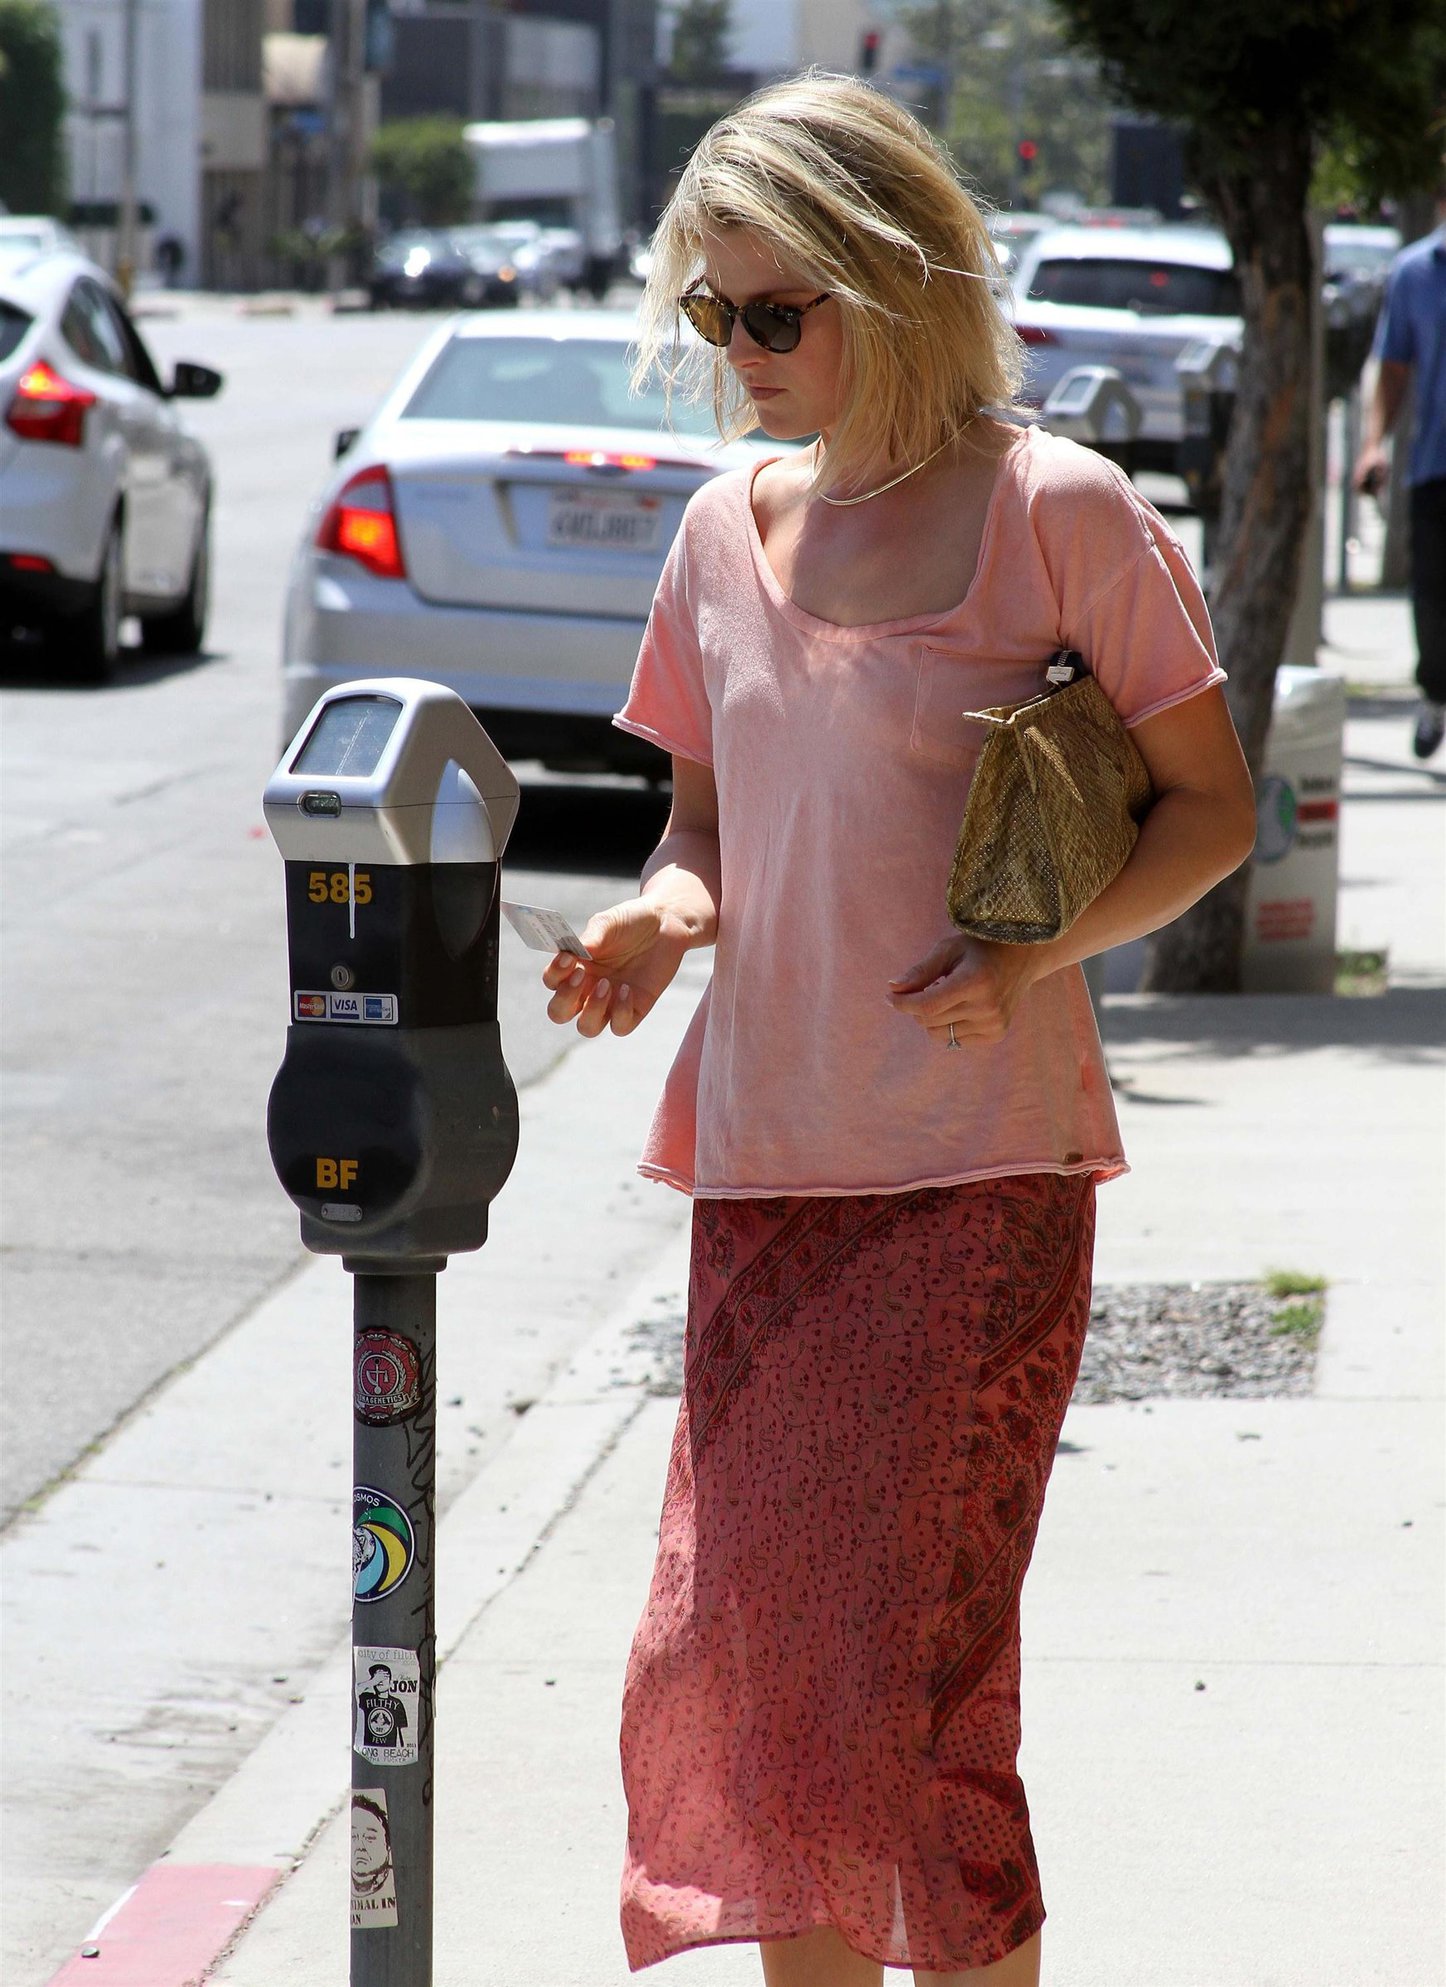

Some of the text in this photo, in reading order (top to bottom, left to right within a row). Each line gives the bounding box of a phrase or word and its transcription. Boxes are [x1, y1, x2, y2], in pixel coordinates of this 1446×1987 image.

[308, 872, 373, 905] 585
[334, 999, 358, 1011] VISA
[316, 1157, 359, 1190] BF
[389, 1680, 418, 1693] JON
[366, 1698, 400, 1710] FILTHY
[383, 1748, 415, 1759] BEACH
